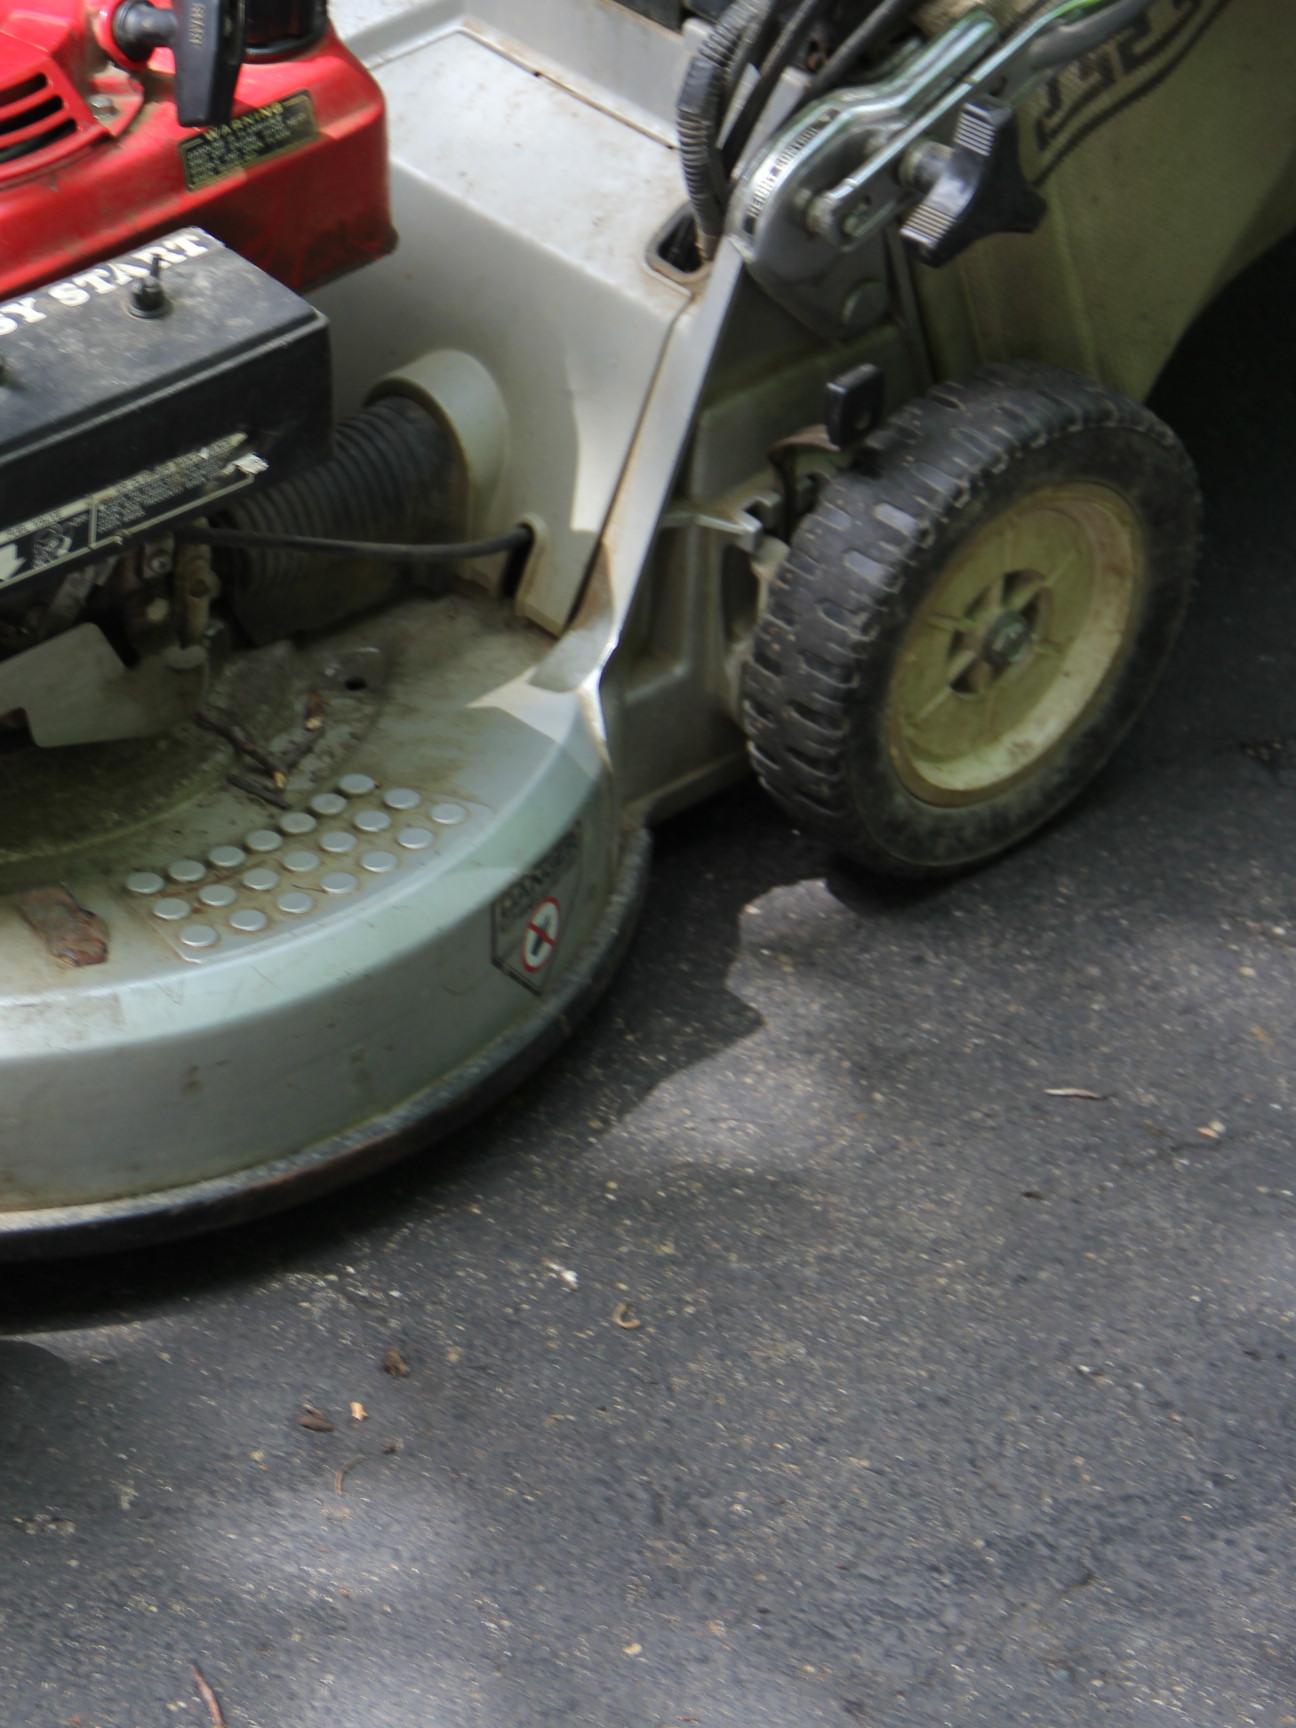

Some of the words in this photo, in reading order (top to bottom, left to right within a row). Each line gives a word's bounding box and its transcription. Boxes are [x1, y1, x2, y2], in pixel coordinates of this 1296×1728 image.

[204, 102, 284, 141] WARNING
[774, 126, 819, 169] CONTROL
[49, 233, 209, 307] START
